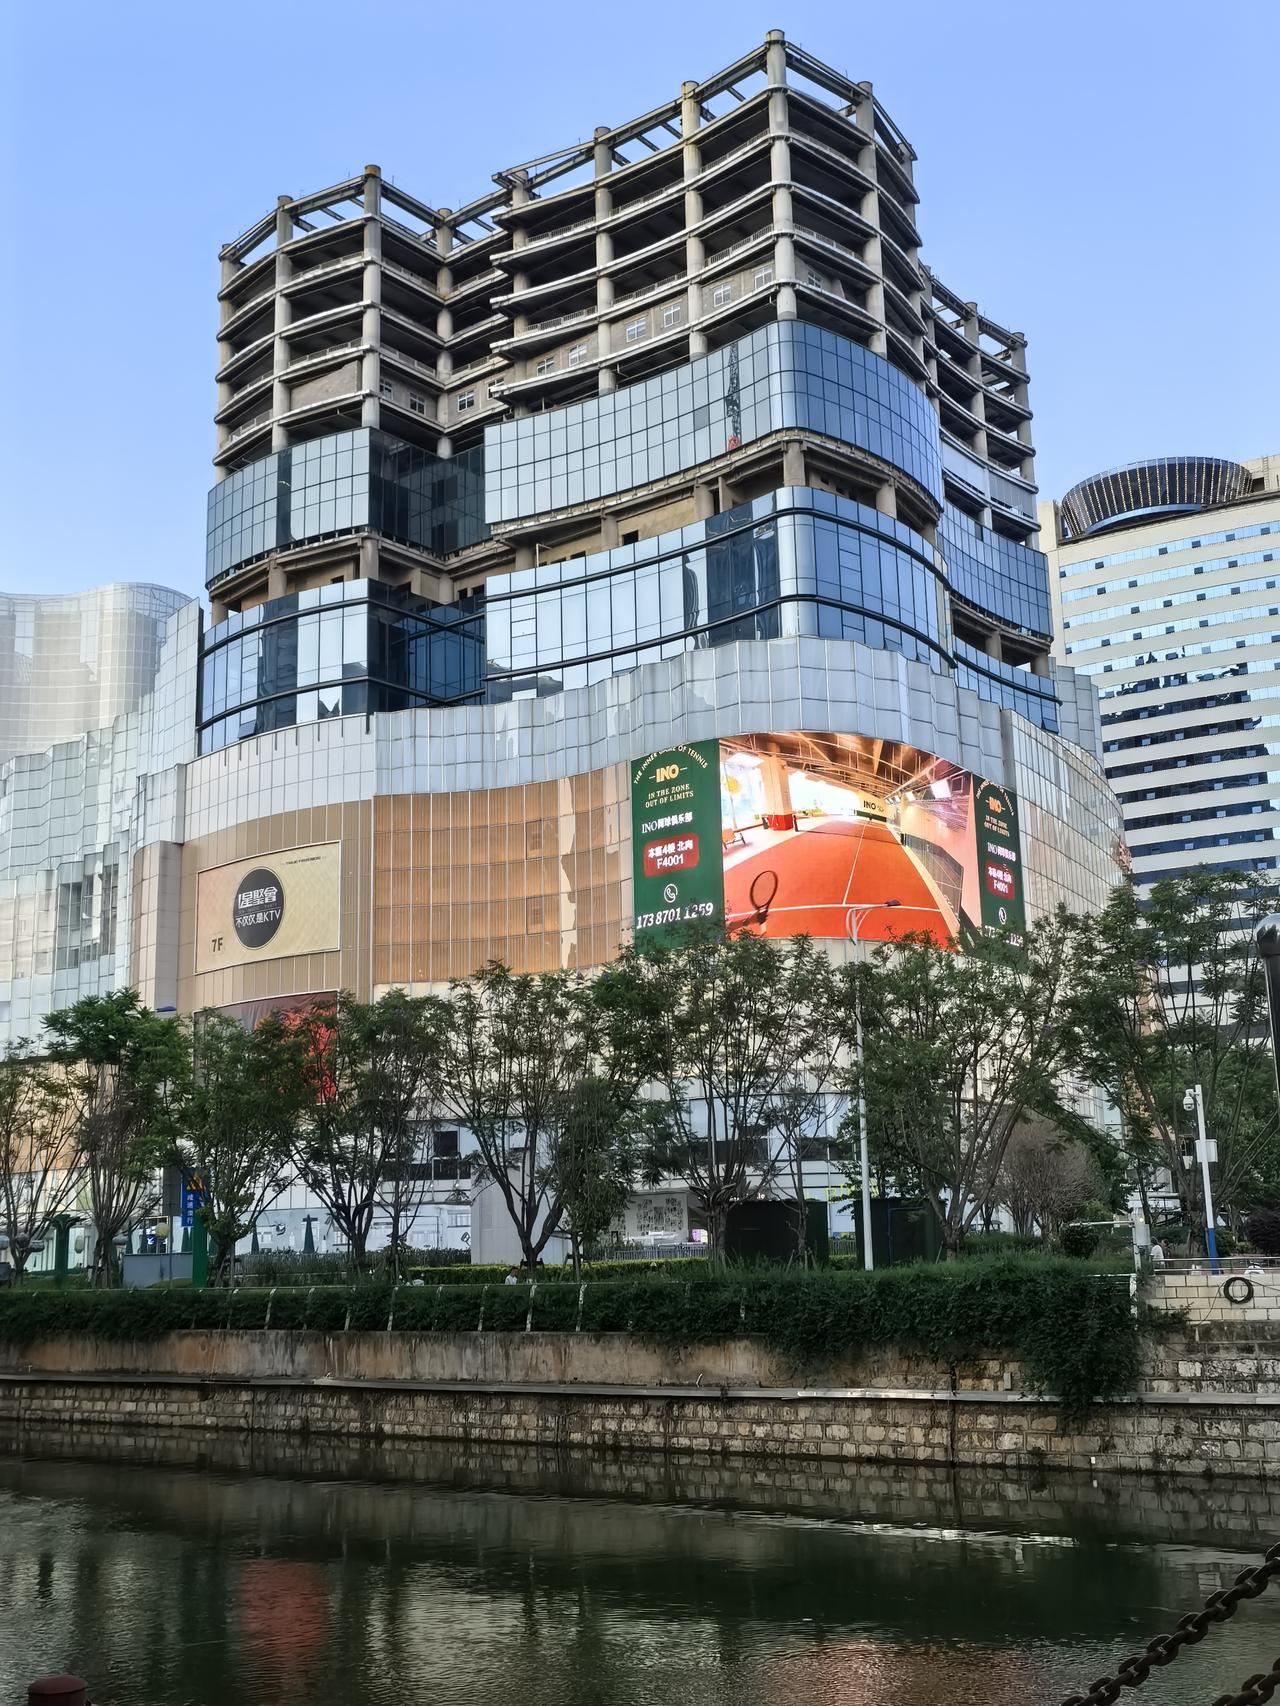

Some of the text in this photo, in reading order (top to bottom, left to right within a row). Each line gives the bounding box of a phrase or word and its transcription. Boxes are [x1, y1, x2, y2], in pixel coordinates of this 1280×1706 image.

[633, 770, 643, 785] THE
[687, 747, 709, 769] TENNIS
[656, 764, 679, 783] INO
[645, 790, 694, 809] OUT OF LIMITS
[648, 783, 690, 800] IN THE ZONE
[863, 800, 876, 810] INO
[656, 853, 684, 869] F4001
[238, 886, 278, 909] 星聚會
[235, 909, 281, 928] 不仅仅是KTV
[211, 937, 224, 953] 7F
